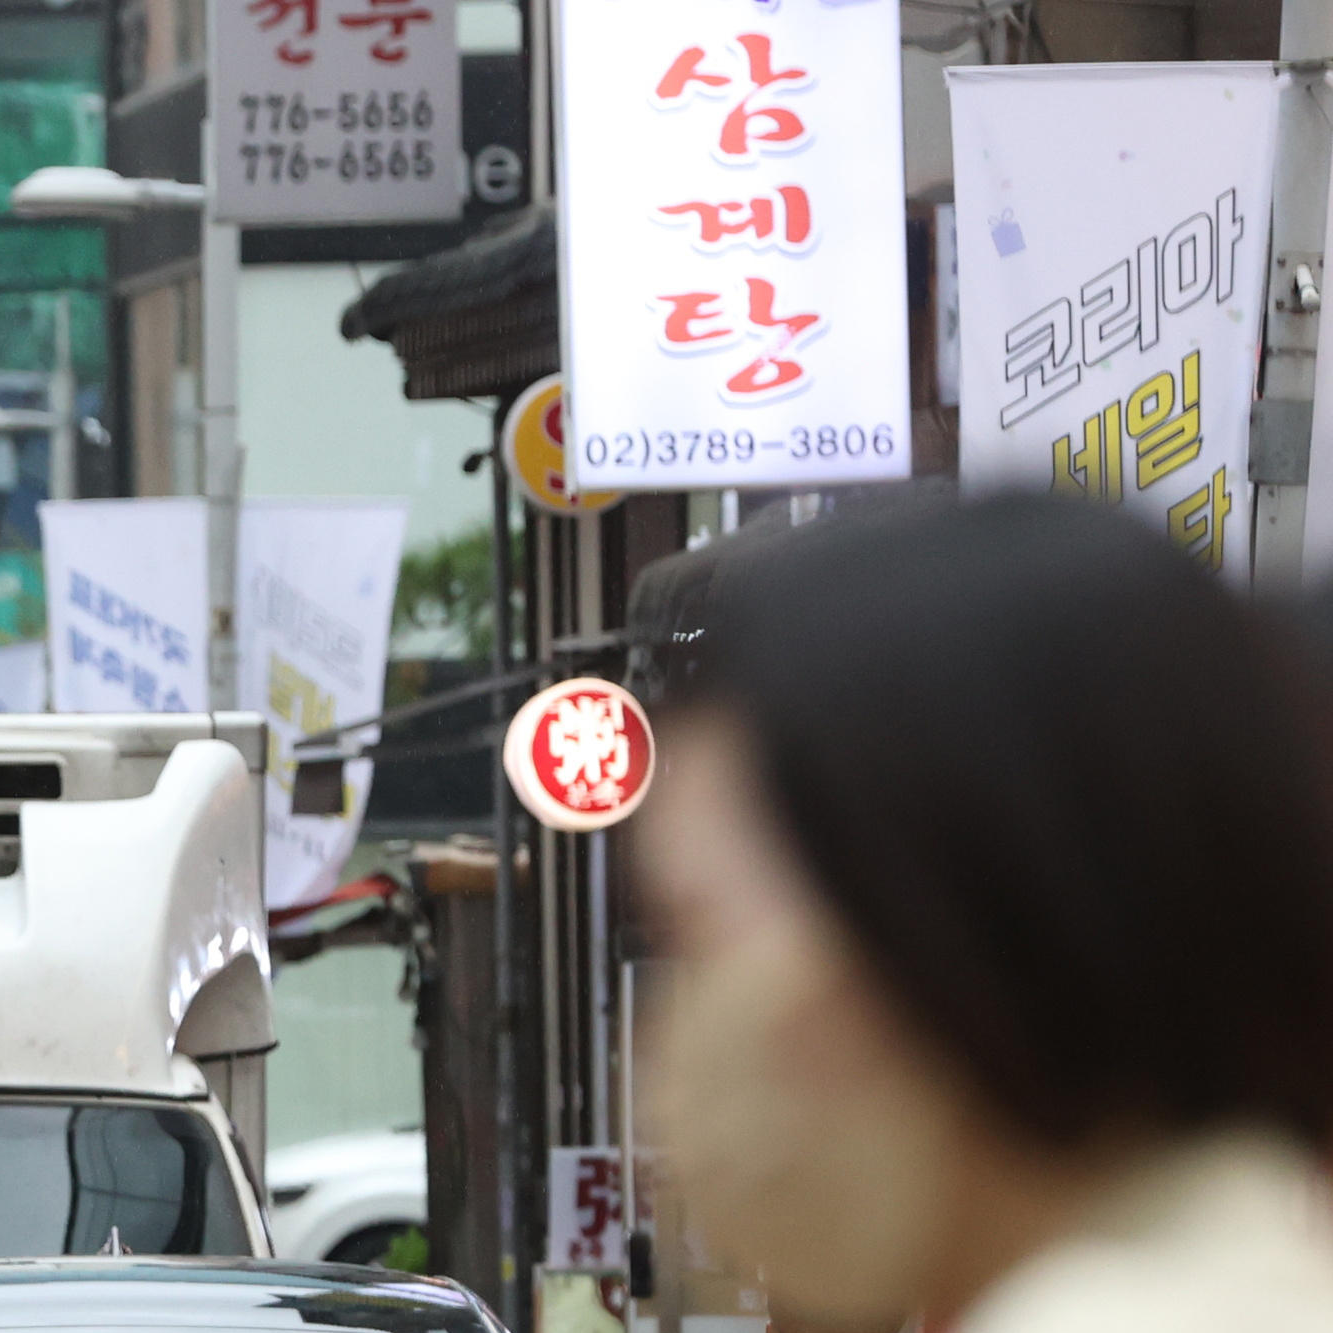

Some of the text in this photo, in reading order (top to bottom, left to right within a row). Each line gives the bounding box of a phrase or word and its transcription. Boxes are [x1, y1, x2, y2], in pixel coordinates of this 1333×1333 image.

[240, 90, 434, 134] 776-5656
[240, 140, 435, 184] 776-6565
[655, 33, 821, 396] 삼계탕
[1000, 187, 1244, 432] 코리아
[585, 425, 895, 470] 02)3789-3806
[1049, 348, 1203, 506] 세일
